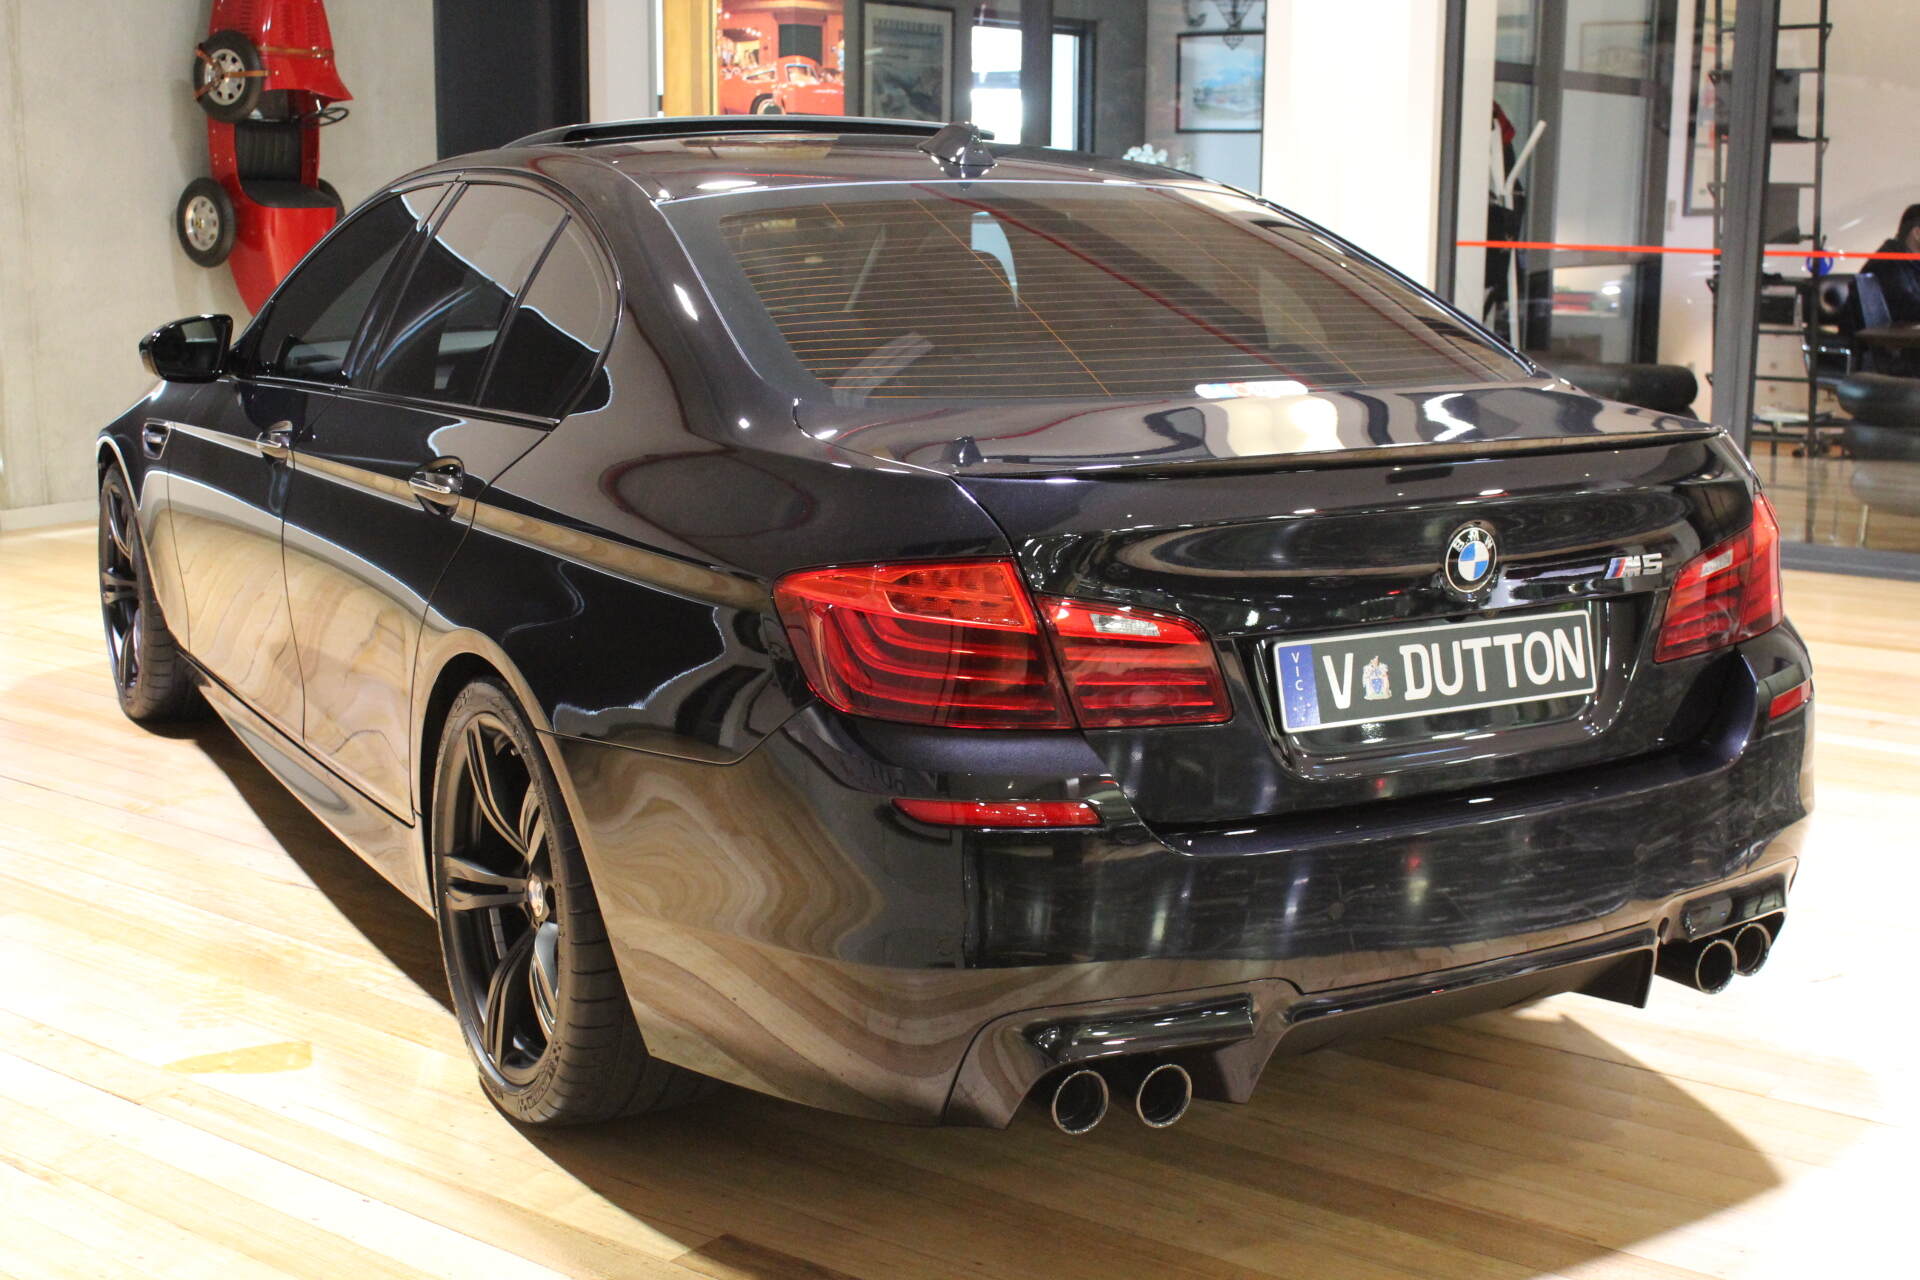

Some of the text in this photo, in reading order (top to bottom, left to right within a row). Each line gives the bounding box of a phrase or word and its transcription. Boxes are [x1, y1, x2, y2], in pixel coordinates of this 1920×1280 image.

[1452, 529, 1494, 552] BMW
[1611, 553, 1662, 579] M5
[1291, 651, 1304, 691] VIC
[1322, 626, 1586, 709] V DUTTON
